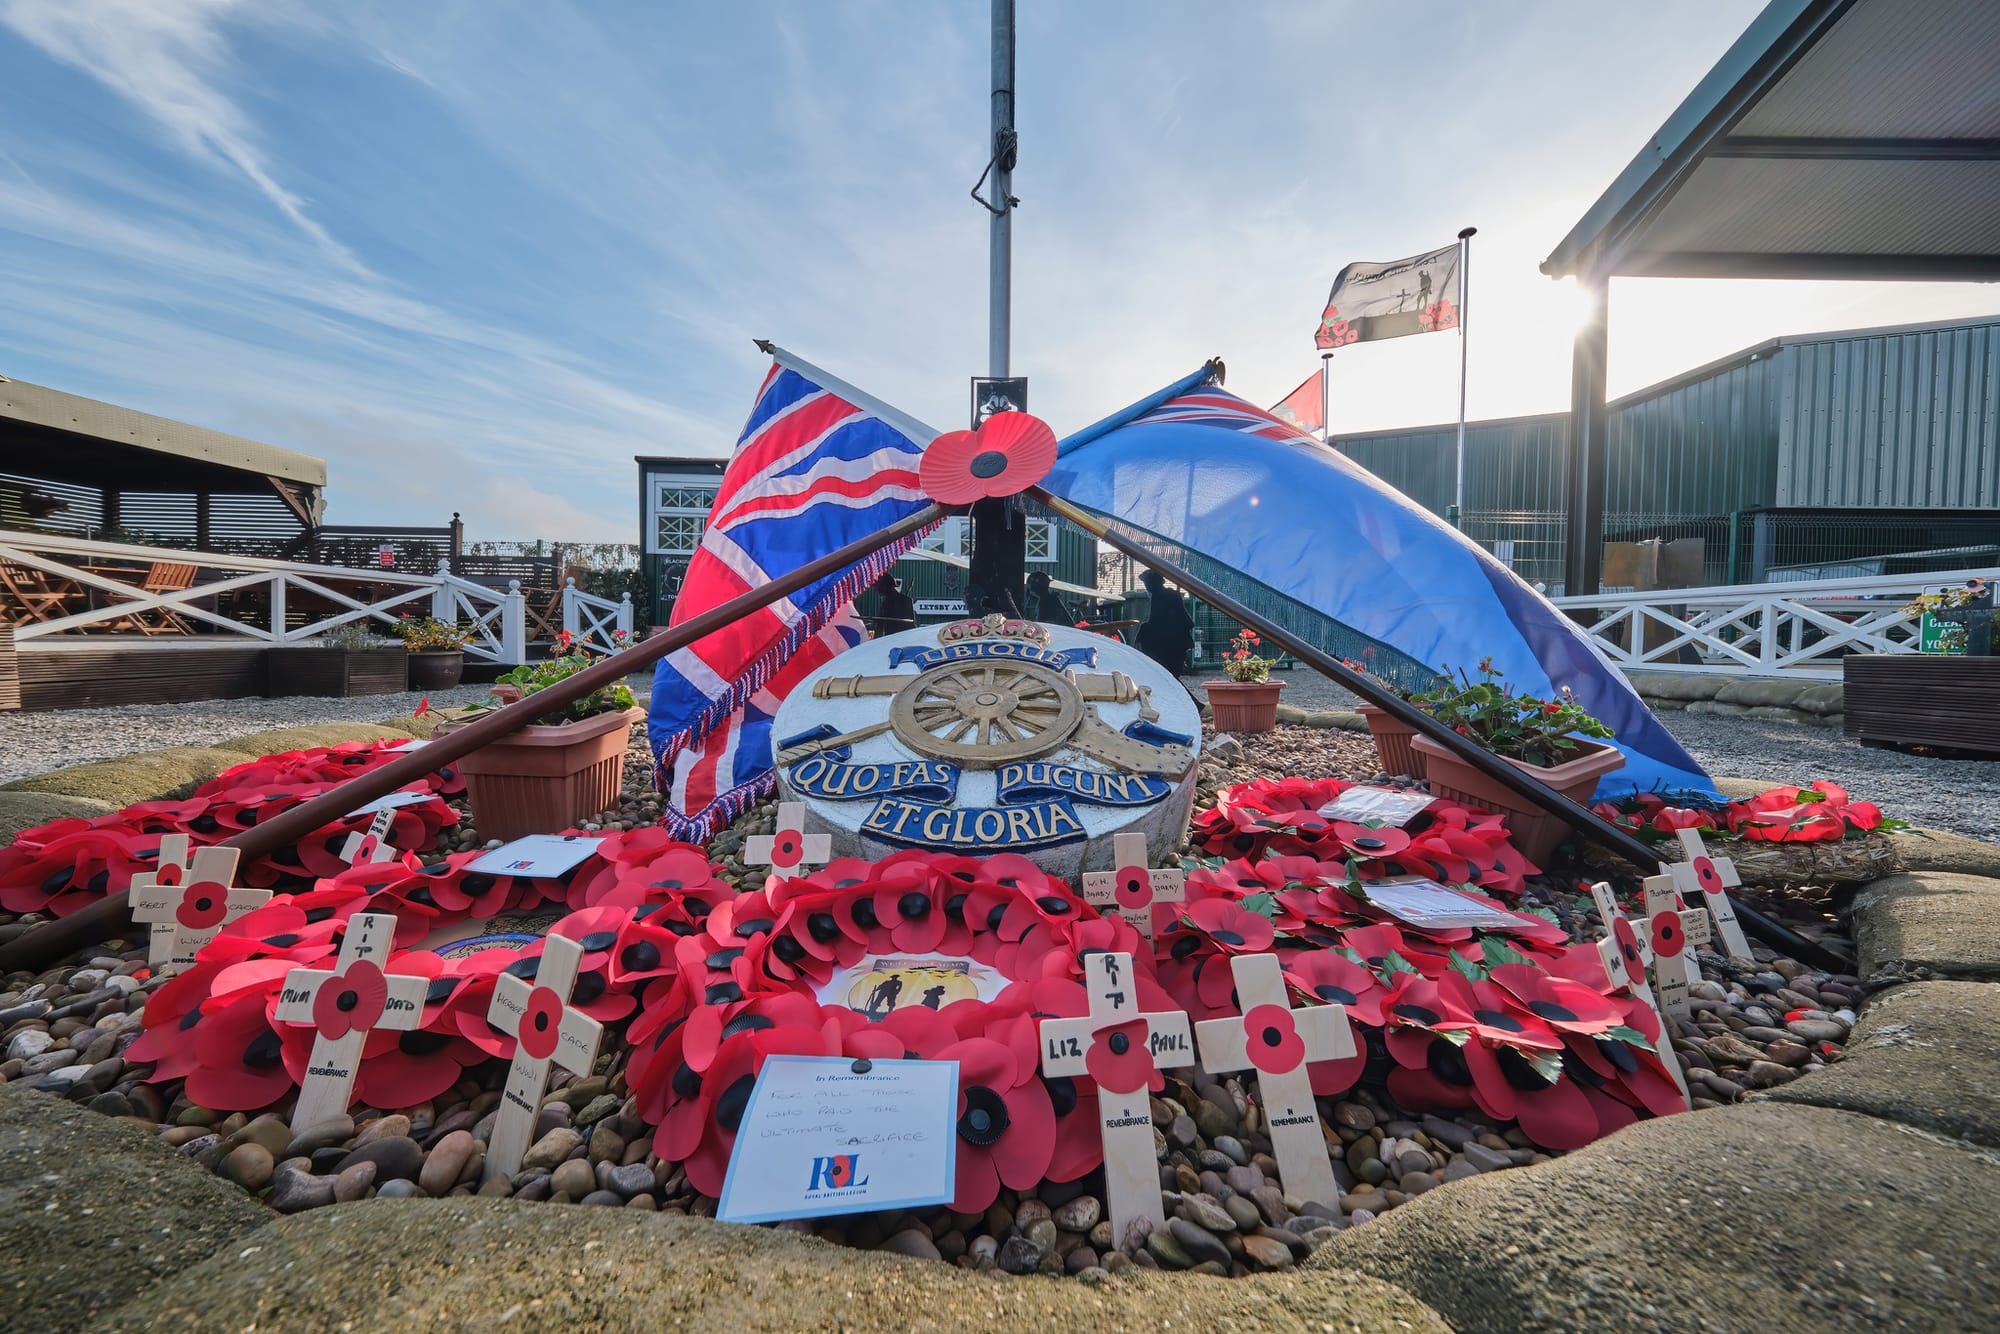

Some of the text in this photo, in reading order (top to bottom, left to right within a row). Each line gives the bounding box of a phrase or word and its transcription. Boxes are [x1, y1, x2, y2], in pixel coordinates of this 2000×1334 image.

[923, 643, 1069, 665] UBIQUE
[1001, 762, 1159, 801] DUCUNT
[866, 800, 1084, 843] ET GLORIA
[140, 901, 168, 910] BERT
[280, 988, 311, 1004] MUM
[385, 997, 415, 1012] DAD
[1049, 1037, 1082, 1059] LIZ
[1150, 1031, 1189, 1056] PAUL
[308, 1067, 349, 1079] REMEMBRANCE
[828, 1074, 900, 1082] Remembrance
[1123, 1109, 1130, 1118] IN
[1287, 1108, 1294, 1116] IN
[1106, 1116, 1150, 1129] REMEMBRANCE
[1270, 1115, 1315, 1127] REMEMBRANCE
[835, 1132, 928, 1146] SACRIFICE
